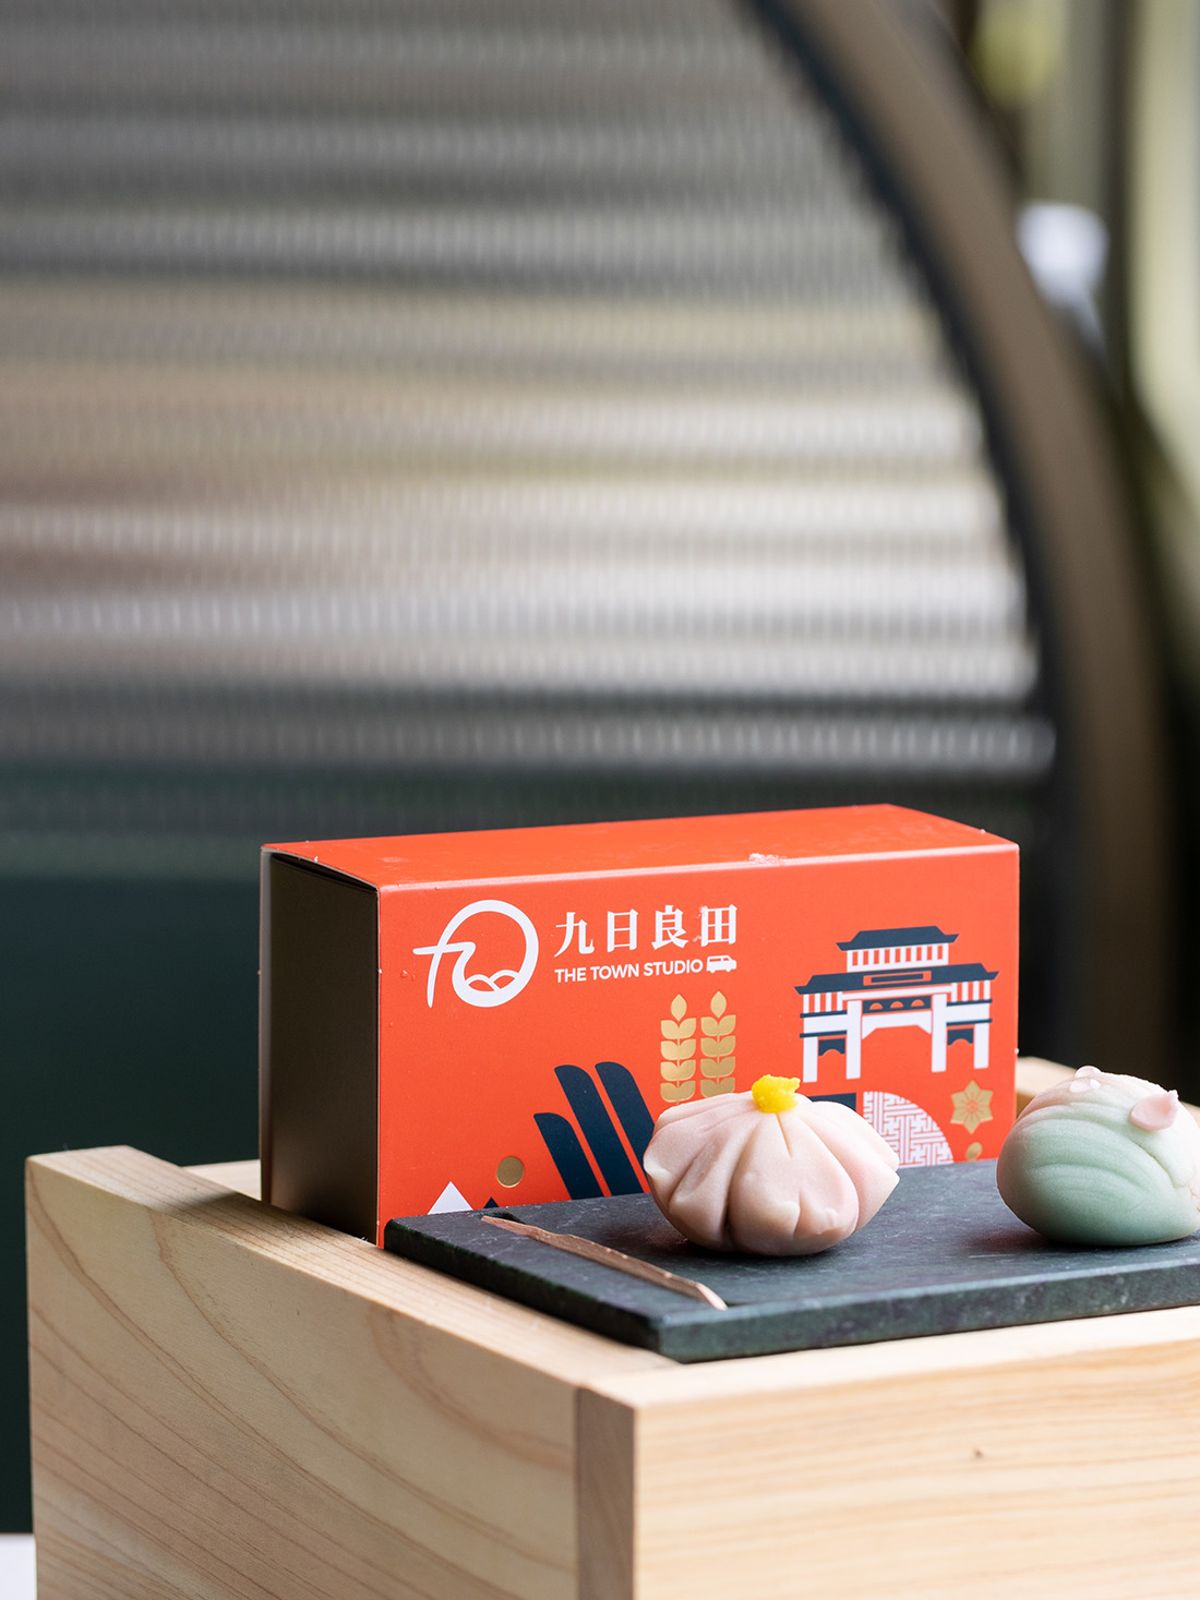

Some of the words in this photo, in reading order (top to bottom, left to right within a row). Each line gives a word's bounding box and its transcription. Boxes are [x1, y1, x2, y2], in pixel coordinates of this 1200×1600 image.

[554, 904, 738, 958] 九日良田
[554, 967, 587, 983] THE
[590, 963, 640, 981] TOWN
[643, 959, 704, 977] STUDIO
